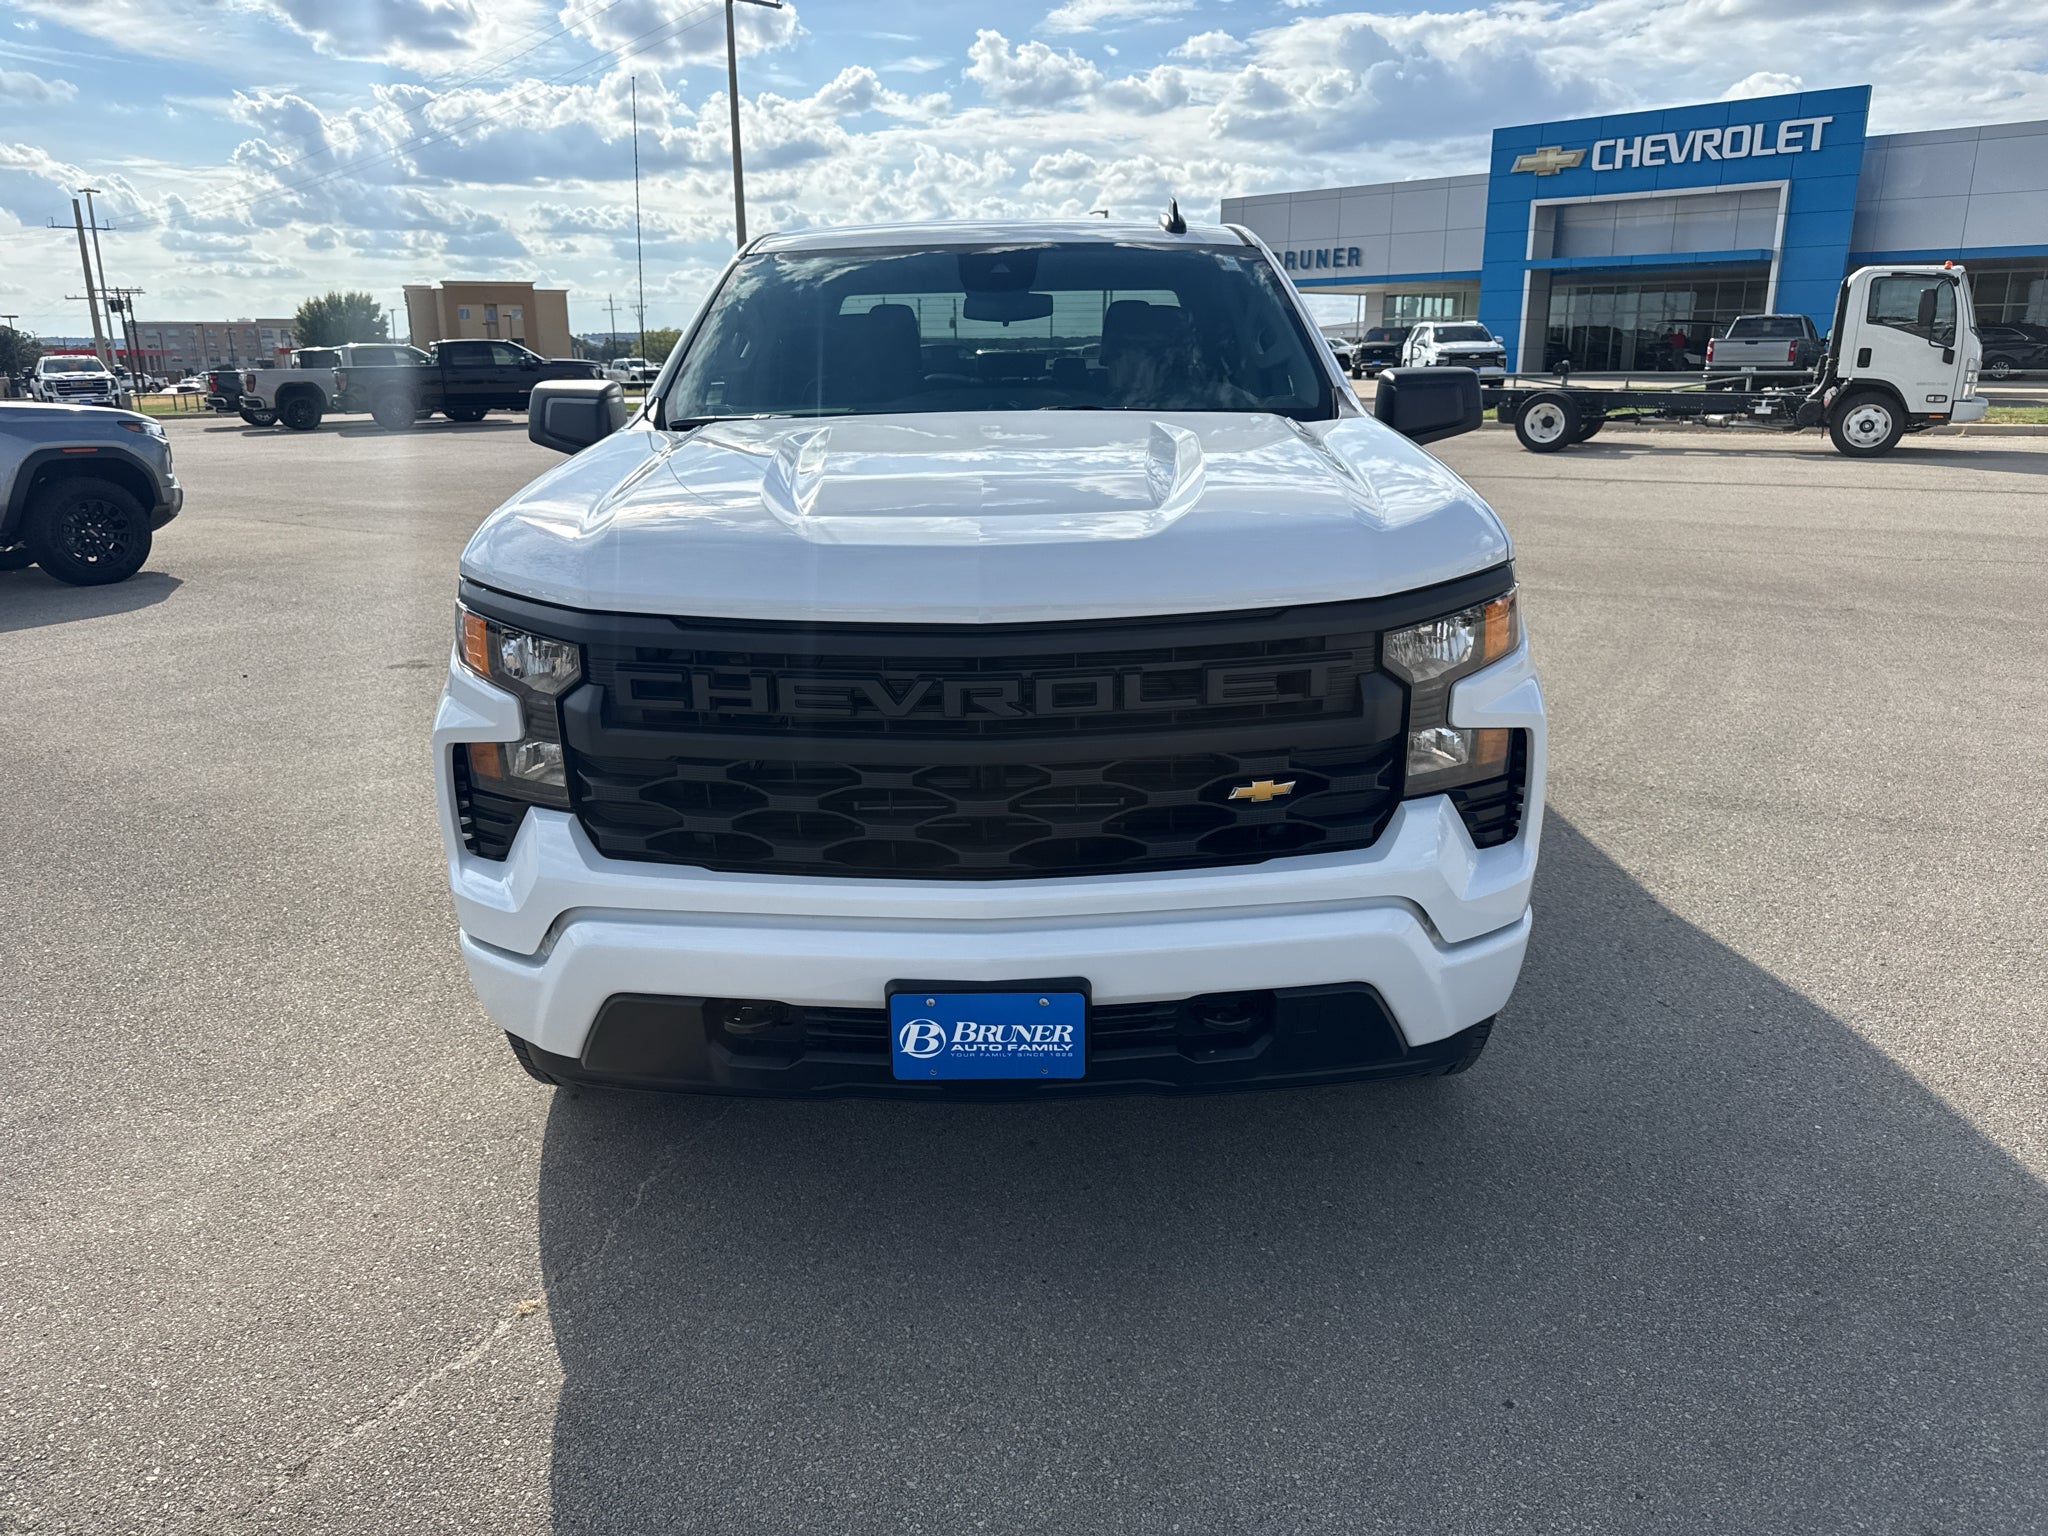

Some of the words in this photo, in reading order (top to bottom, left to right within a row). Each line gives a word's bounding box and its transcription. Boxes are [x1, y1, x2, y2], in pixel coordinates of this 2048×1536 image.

[1591, 116, 1834, 172] CHEVROLET
[615, 651, 1355, 719] CHEVROLET
[951, 1043, 1003, 1052] AUTO
[1007, 1043, 1074, 1052] FAMILY
